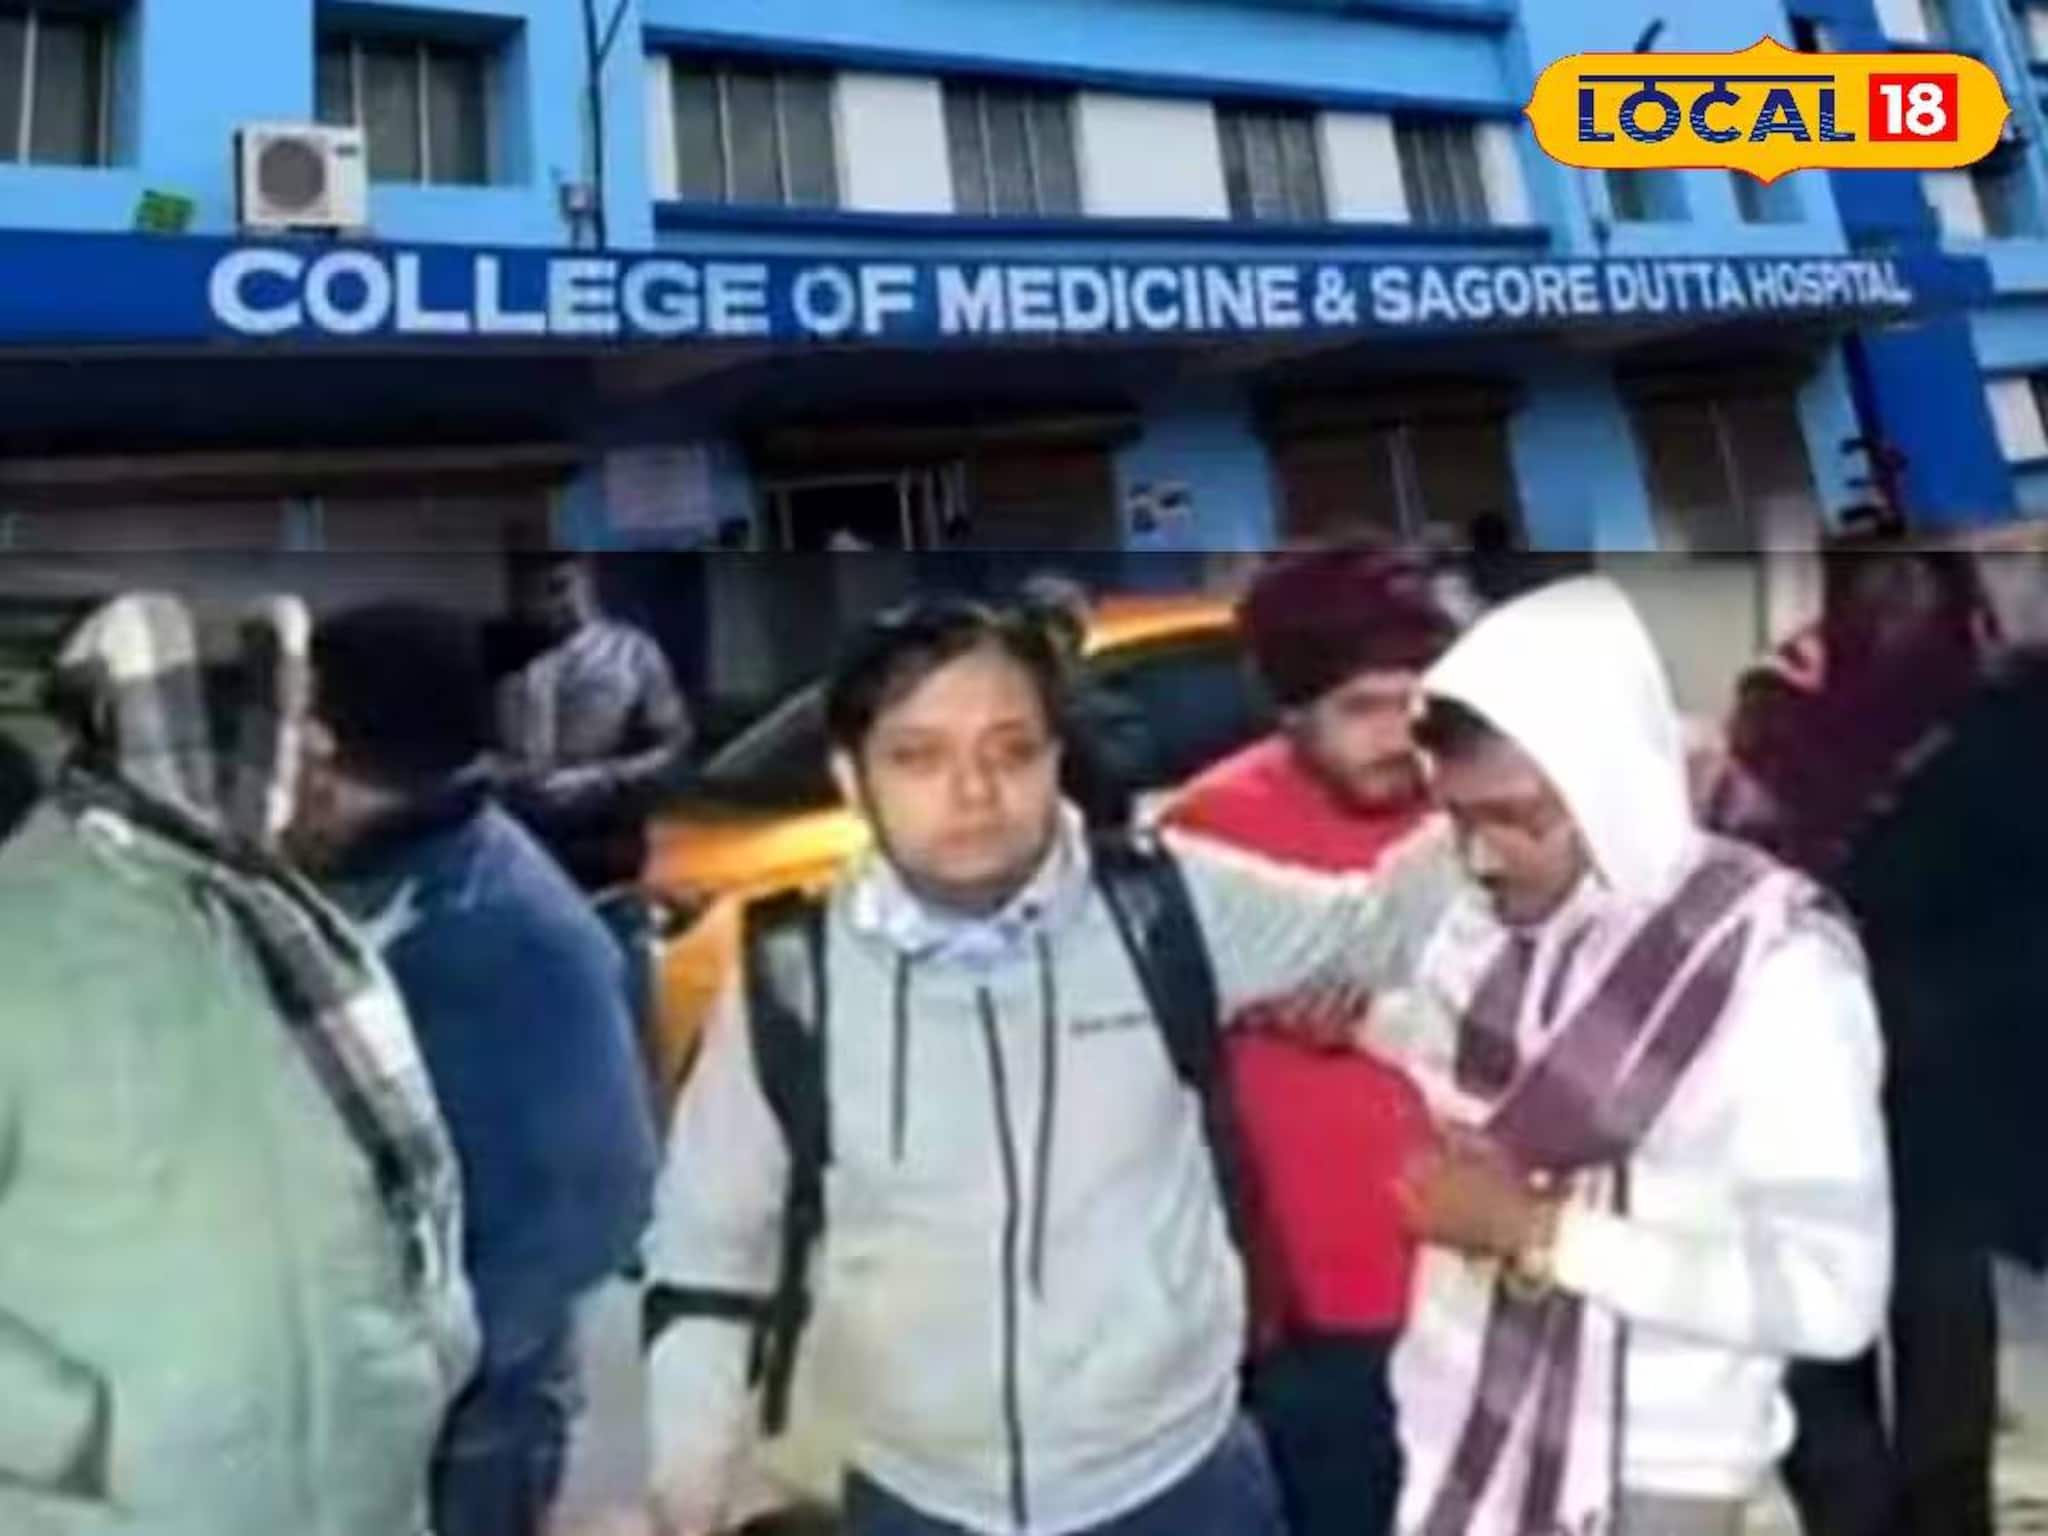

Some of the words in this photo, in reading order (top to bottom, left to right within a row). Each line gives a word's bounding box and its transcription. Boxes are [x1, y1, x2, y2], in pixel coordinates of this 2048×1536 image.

[208, 249, 768, 335] COLLEGE
[791, 266, 914, 334] OF
[937, 265, 1300, 333] MEDICINE
[1313, 273, 1358, 326] &
[1370, 265, 1600, 323] SAGORE
[1606, 262, 1745, 316] DUTTA
[1752, 260, 1911, 306] HOSPITAL
